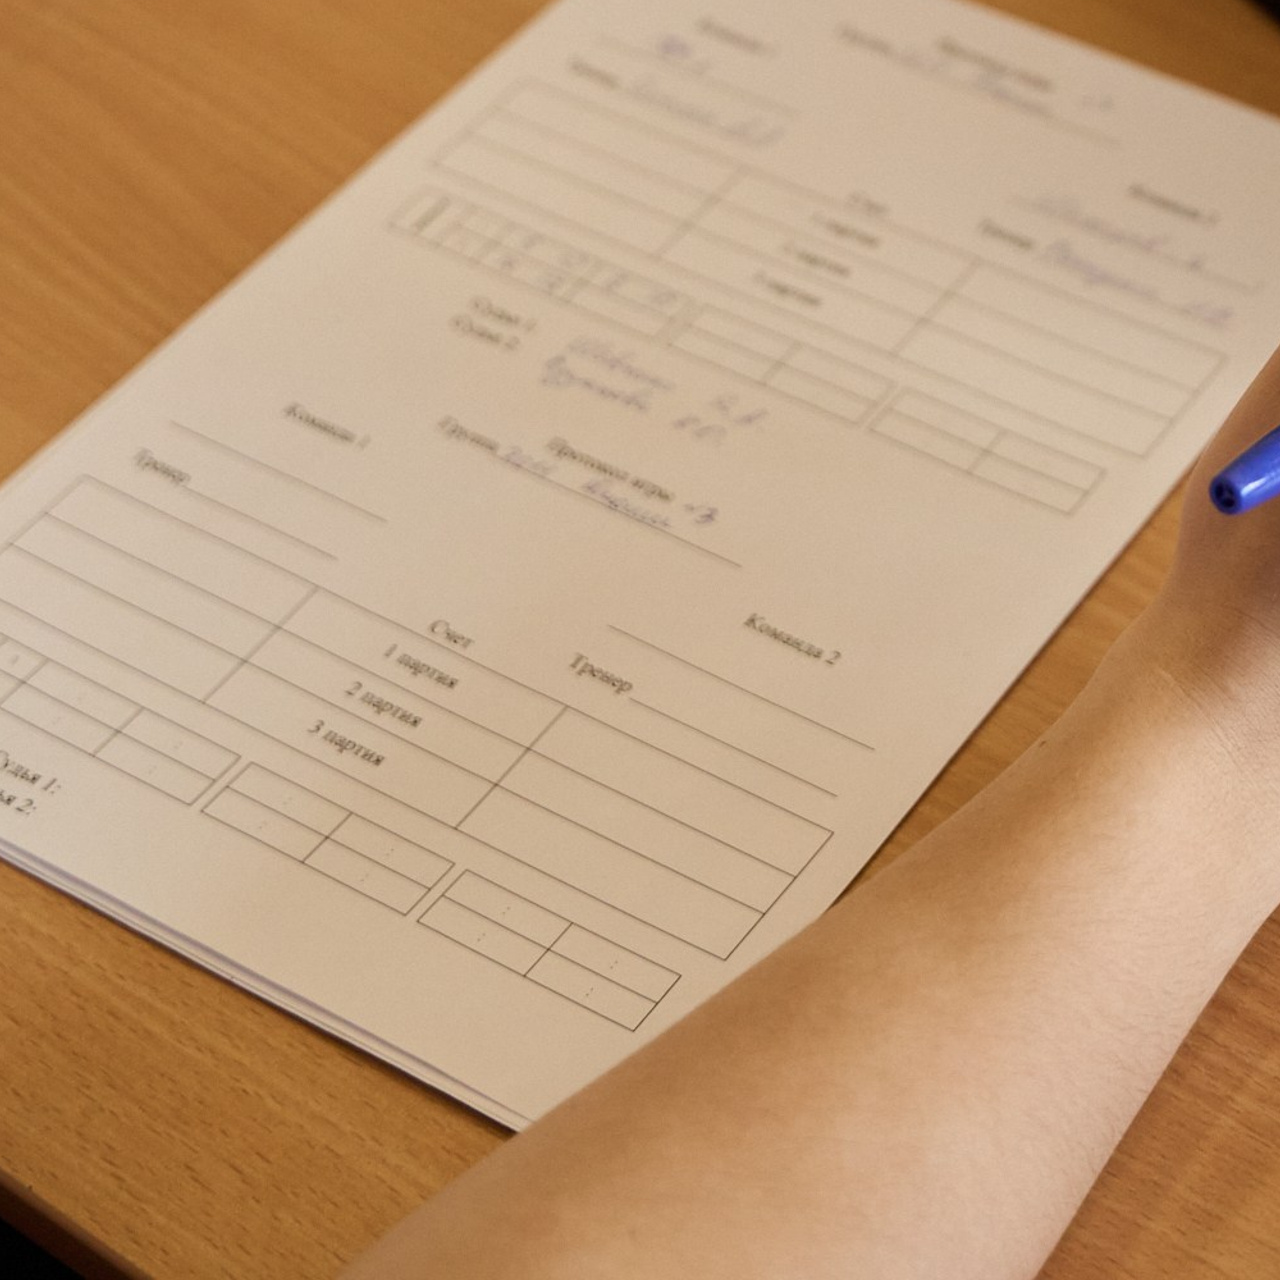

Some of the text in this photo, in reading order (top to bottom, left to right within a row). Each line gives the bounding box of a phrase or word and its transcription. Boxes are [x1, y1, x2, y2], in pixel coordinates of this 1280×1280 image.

[743, 612, 842, 667] Команда 2
[396, 653, 459, 689] партия
[569, 651, 634, 695] Тренер
[345, 680, 423, 728] 2 партия
[307, 719, 385, 766] 3 партия
